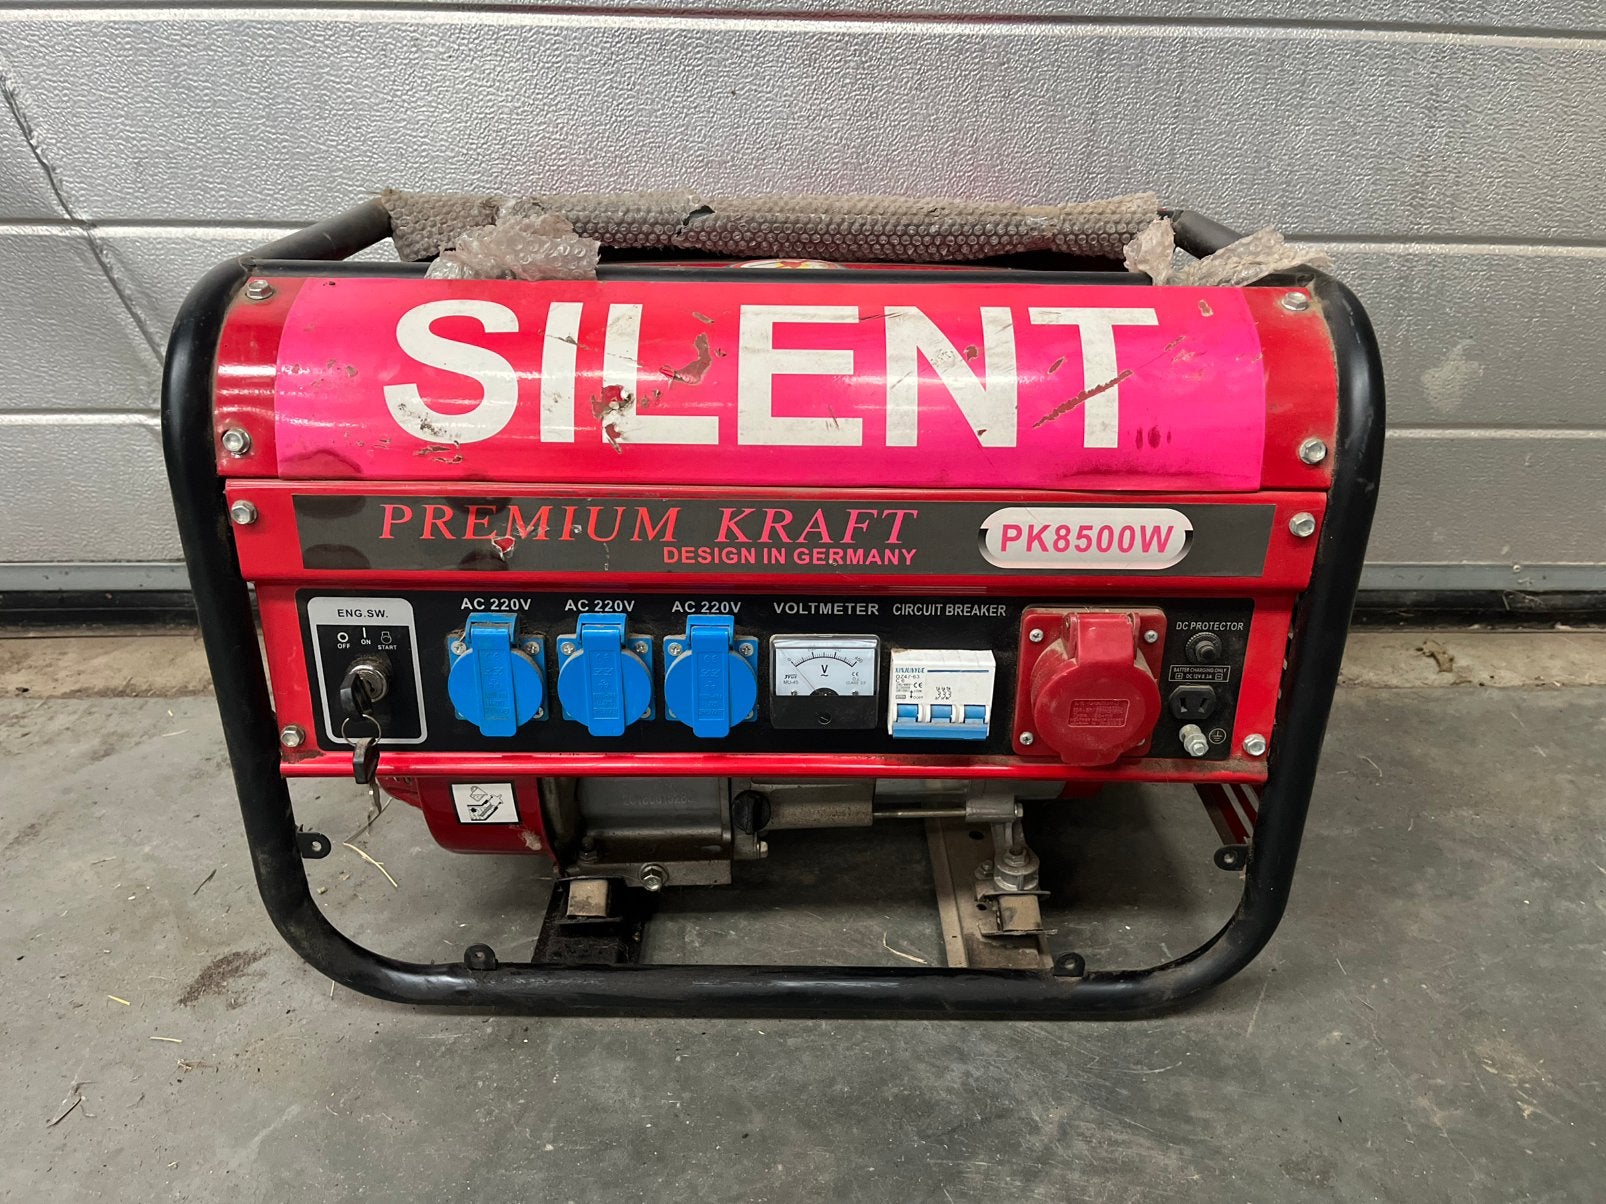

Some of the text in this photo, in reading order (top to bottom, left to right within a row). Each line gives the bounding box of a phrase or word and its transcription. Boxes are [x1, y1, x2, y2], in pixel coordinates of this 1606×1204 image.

[384, 299, 1159, 449] SILENT
[378, 503, 918, 545] PREMIUM KRAFT
[1000, 523, 1174, 554] PK8500W
[662, 546, 917, 566] DESIGN IN GERMANY
[460, 597, 532, 611] AC 220V
[564, 599, 635, 612] AC 220V
[671, 600, 742, 614] AC 220V
[773, 601, 879, 615] VOLTMETER
[892, 603, 1007, 617] CIRCUIT BREAKER
[337, 608, 389, 618] ENG.SW.
[1176, 621, 1244, 631] DC PROTECTOR
